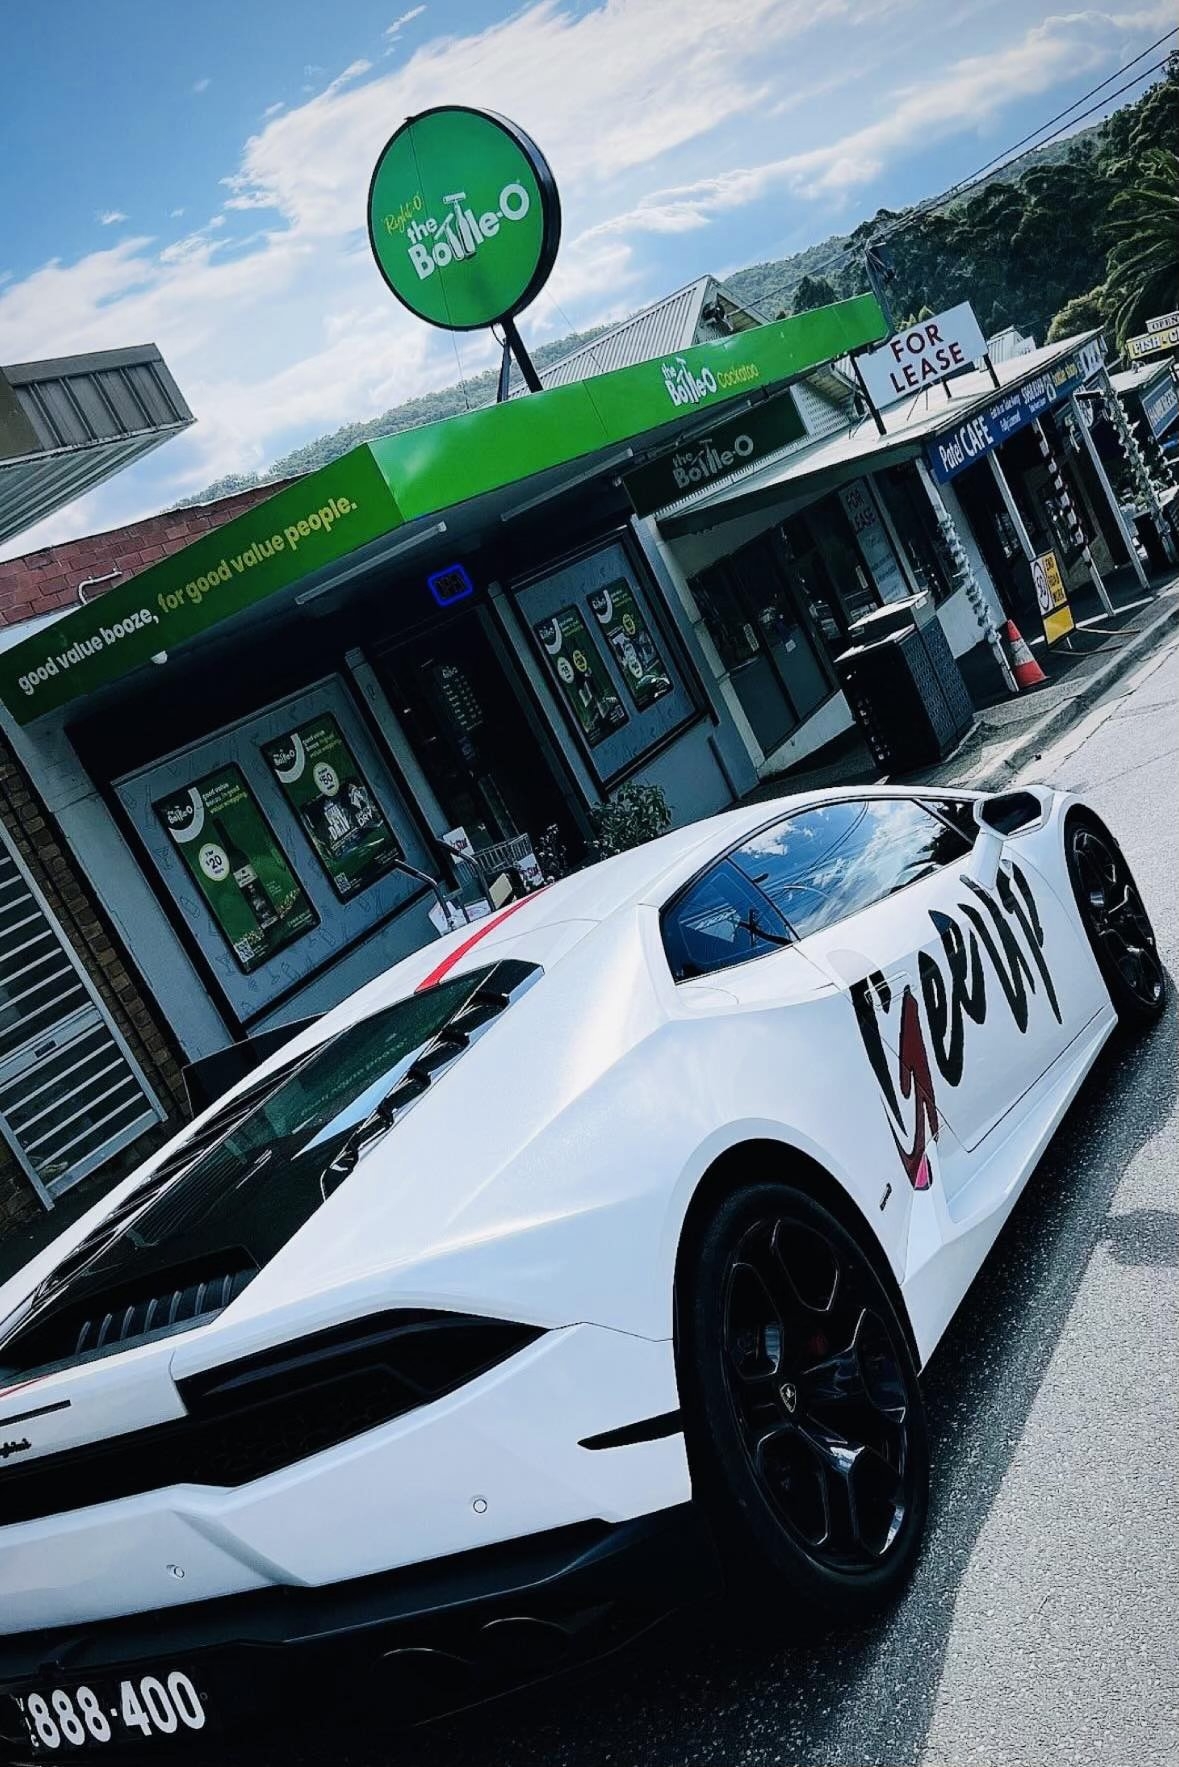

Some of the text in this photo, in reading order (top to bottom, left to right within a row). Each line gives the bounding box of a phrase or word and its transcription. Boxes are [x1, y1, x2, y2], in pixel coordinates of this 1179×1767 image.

[407, 217, 438, 244] the
[890, 324, 944, 363] FOR
[1134, 336, 1160, 355] FISH
[661, 362, 677, 380] the
[717, 363, 760, 389] Cockatoo
[890, 342, 965, 394] LEASE
[960, 416, 994, 457] CAFE
[672, 452, 694, 468] the
[18, 496, 358, 696] good value booze, for good value people.
